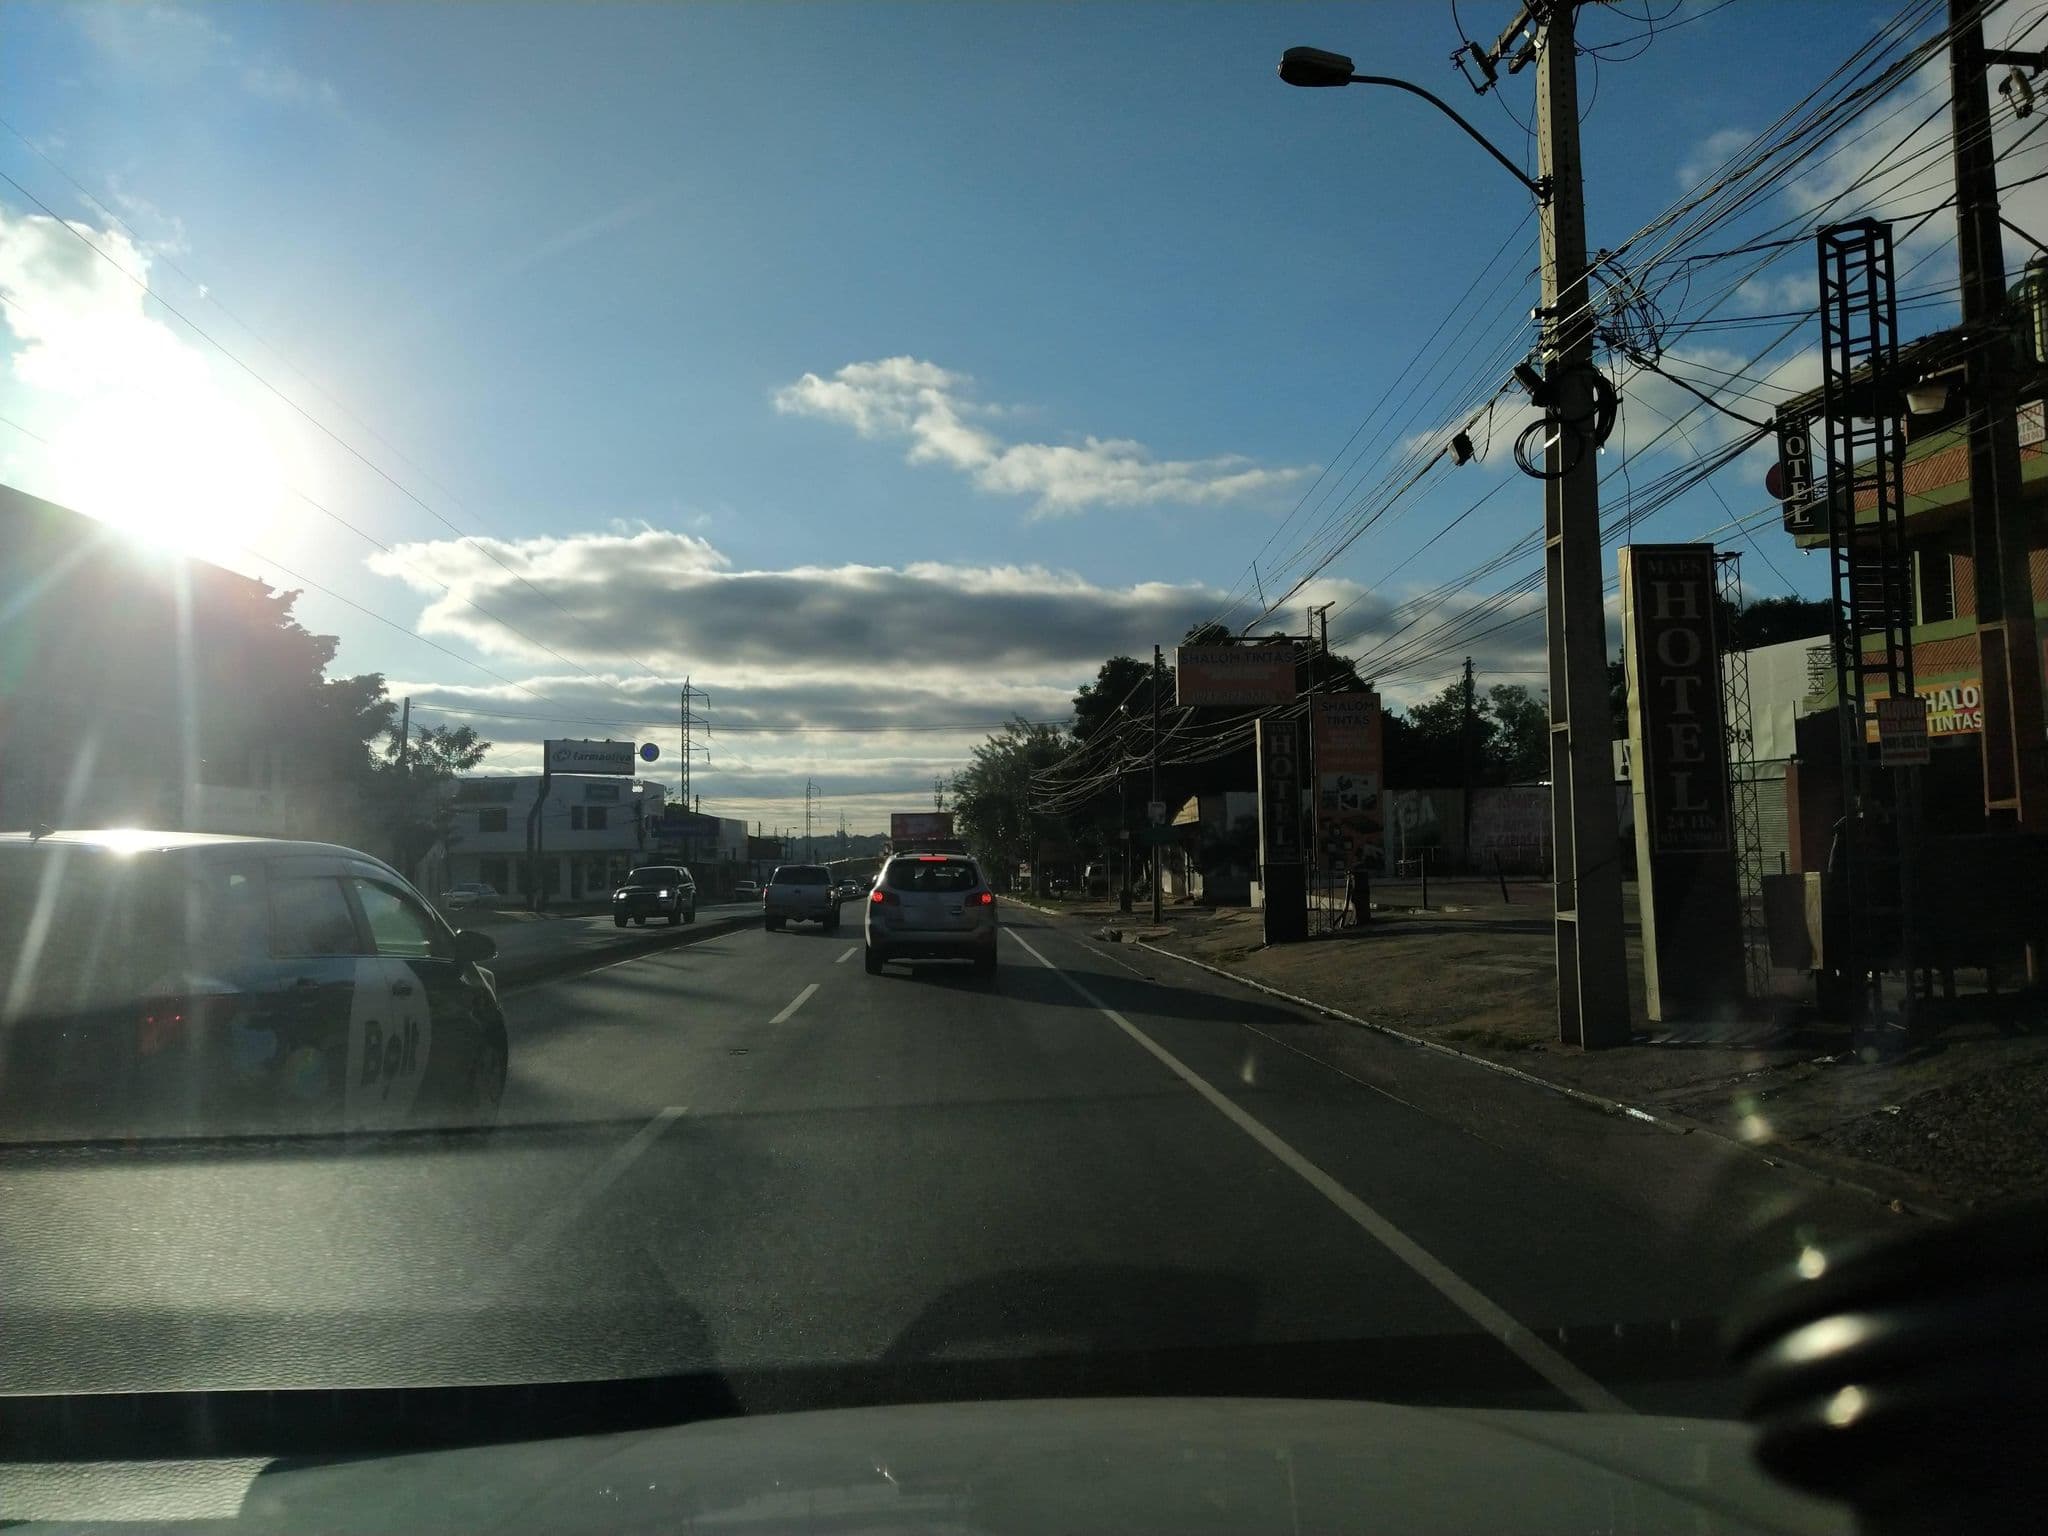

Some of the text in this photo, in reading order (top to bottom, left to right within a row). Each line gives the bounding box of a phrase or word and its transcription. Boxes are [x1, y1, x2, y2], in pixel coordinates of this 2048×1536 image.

[1181, 651, 1294, 665] SHALOM TINTAS
[1650, 580, 1710, 812] HOTEL
[1914, 684, 1983, 713] HALO
[1322, 702, 1375, 712] SHALOM
[1328, 713, 1369, 726] TINTAS
[1926, 711, 1982, 733] TINTAS
